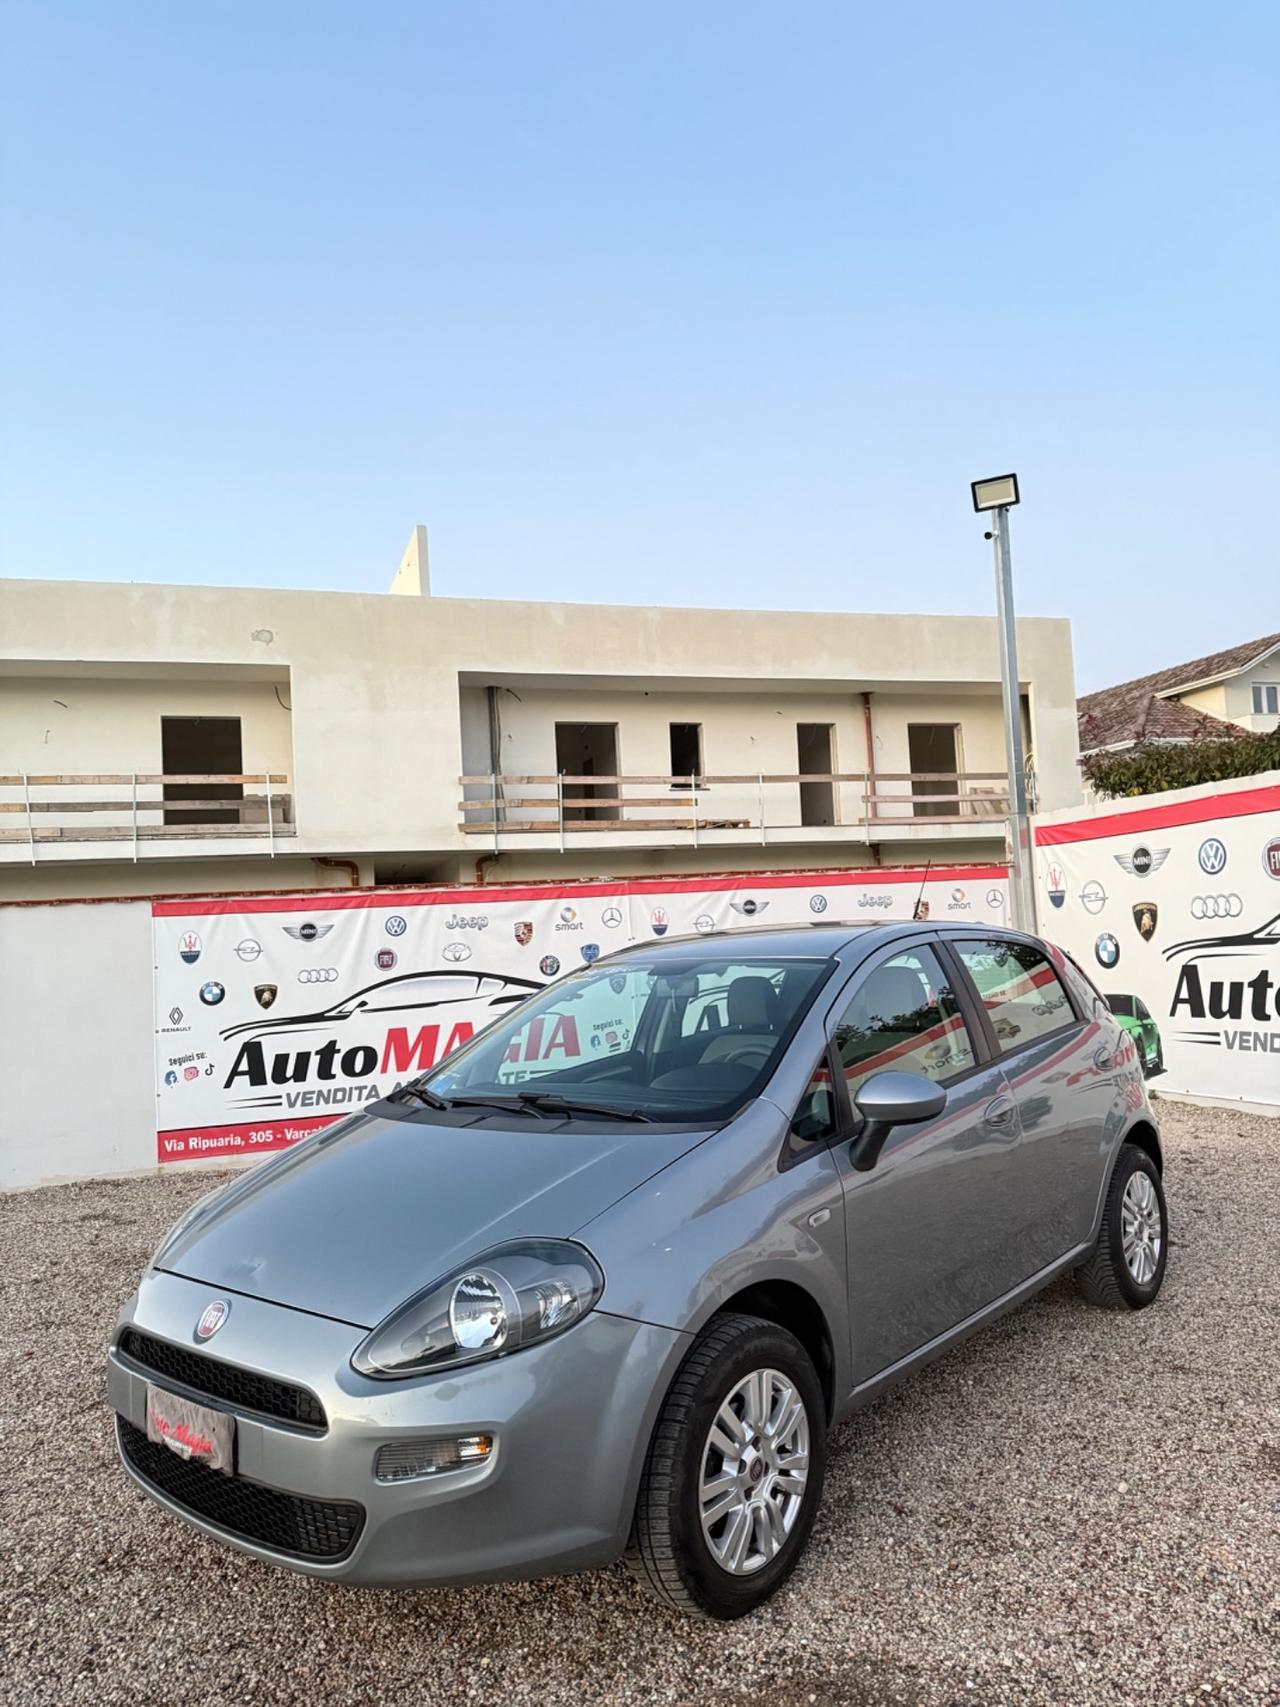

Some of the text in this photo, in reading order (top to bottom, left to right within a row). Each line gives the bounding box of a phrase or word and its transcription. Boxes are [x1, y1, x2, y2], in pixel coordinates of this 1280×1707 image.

[857, 893, 894, 909] Jeep
[947, 901, 972, 911] smart
[445, 914, 489, 931] Jeep
[555, 922, 584, 931] smart
[1169, 964, 1280, 1022] Aut
[168, 1055, 195, 1066] Seguici
[286, 1084, 380, 1109] VENDITA
[164, 1138, 185, 1152] Via
[188, 1132, 245, 1151] Ripuaria,
[249, 1130, 273, 1144] 305
